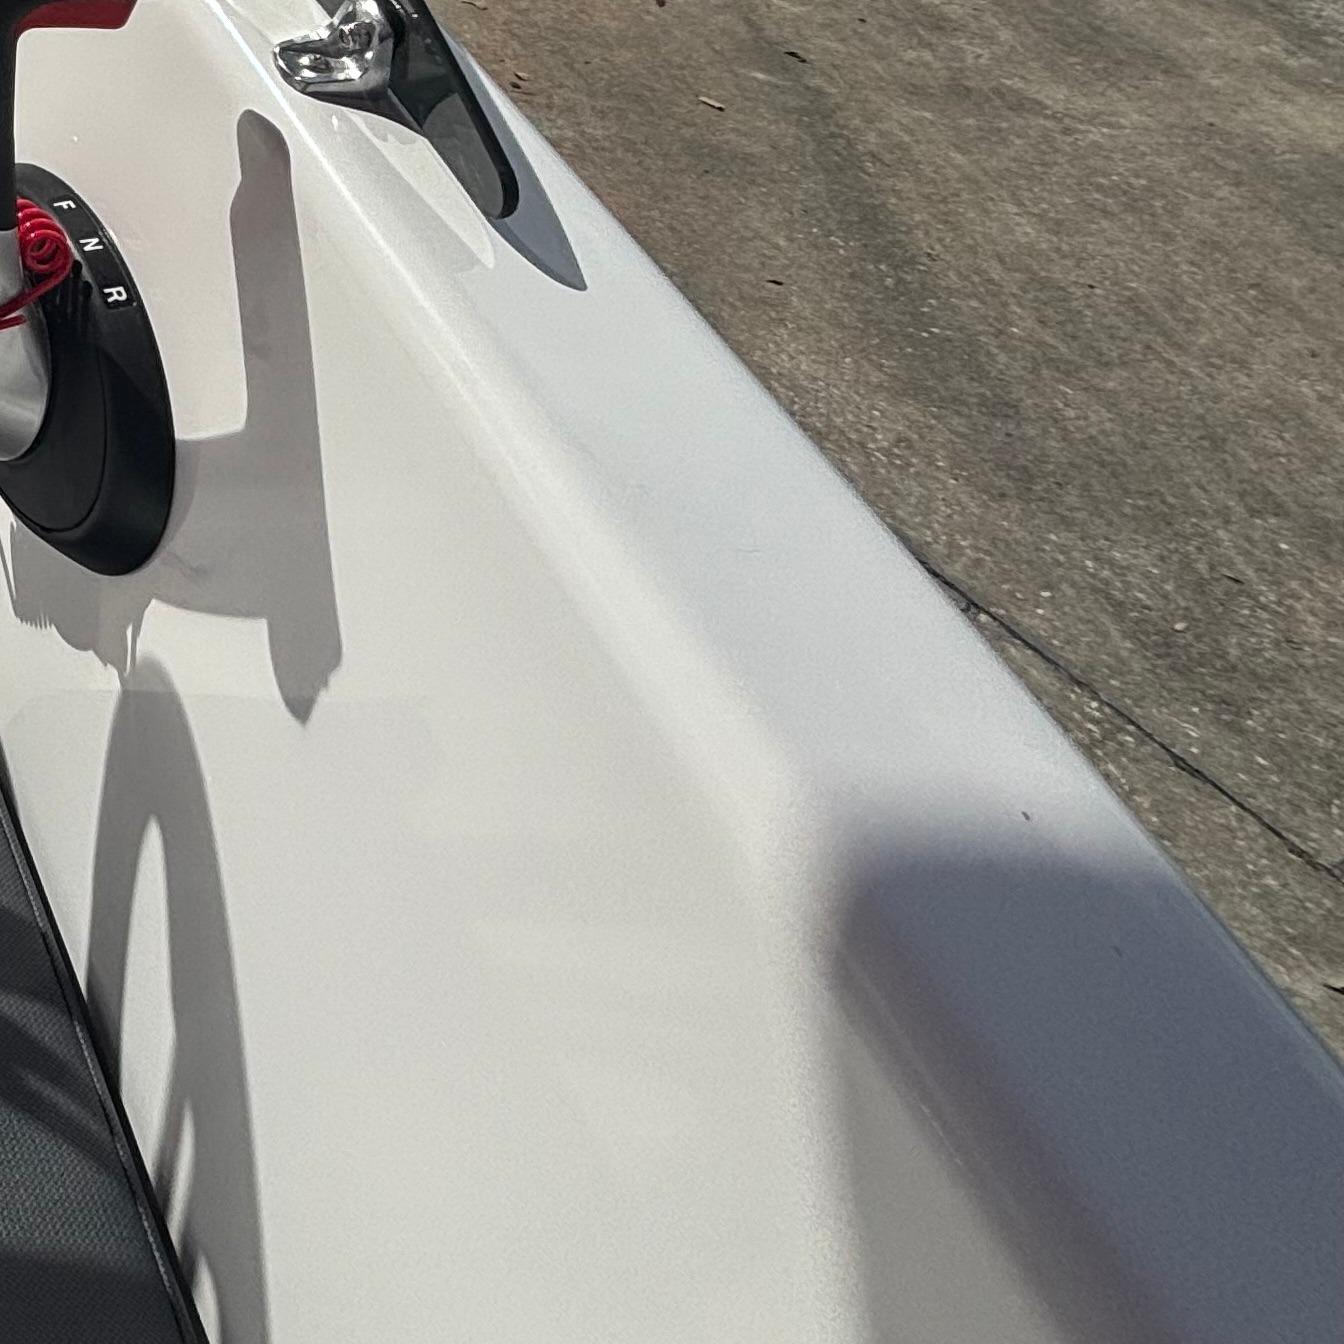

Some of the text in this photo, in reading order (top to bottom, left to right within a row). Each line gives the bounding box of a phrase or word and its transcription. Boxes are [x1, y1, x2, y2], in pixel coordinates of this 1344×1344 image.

[53, 200, 77, 210] F
[79, 237, 104, 252] N
[103, 285, 128, 303] R
